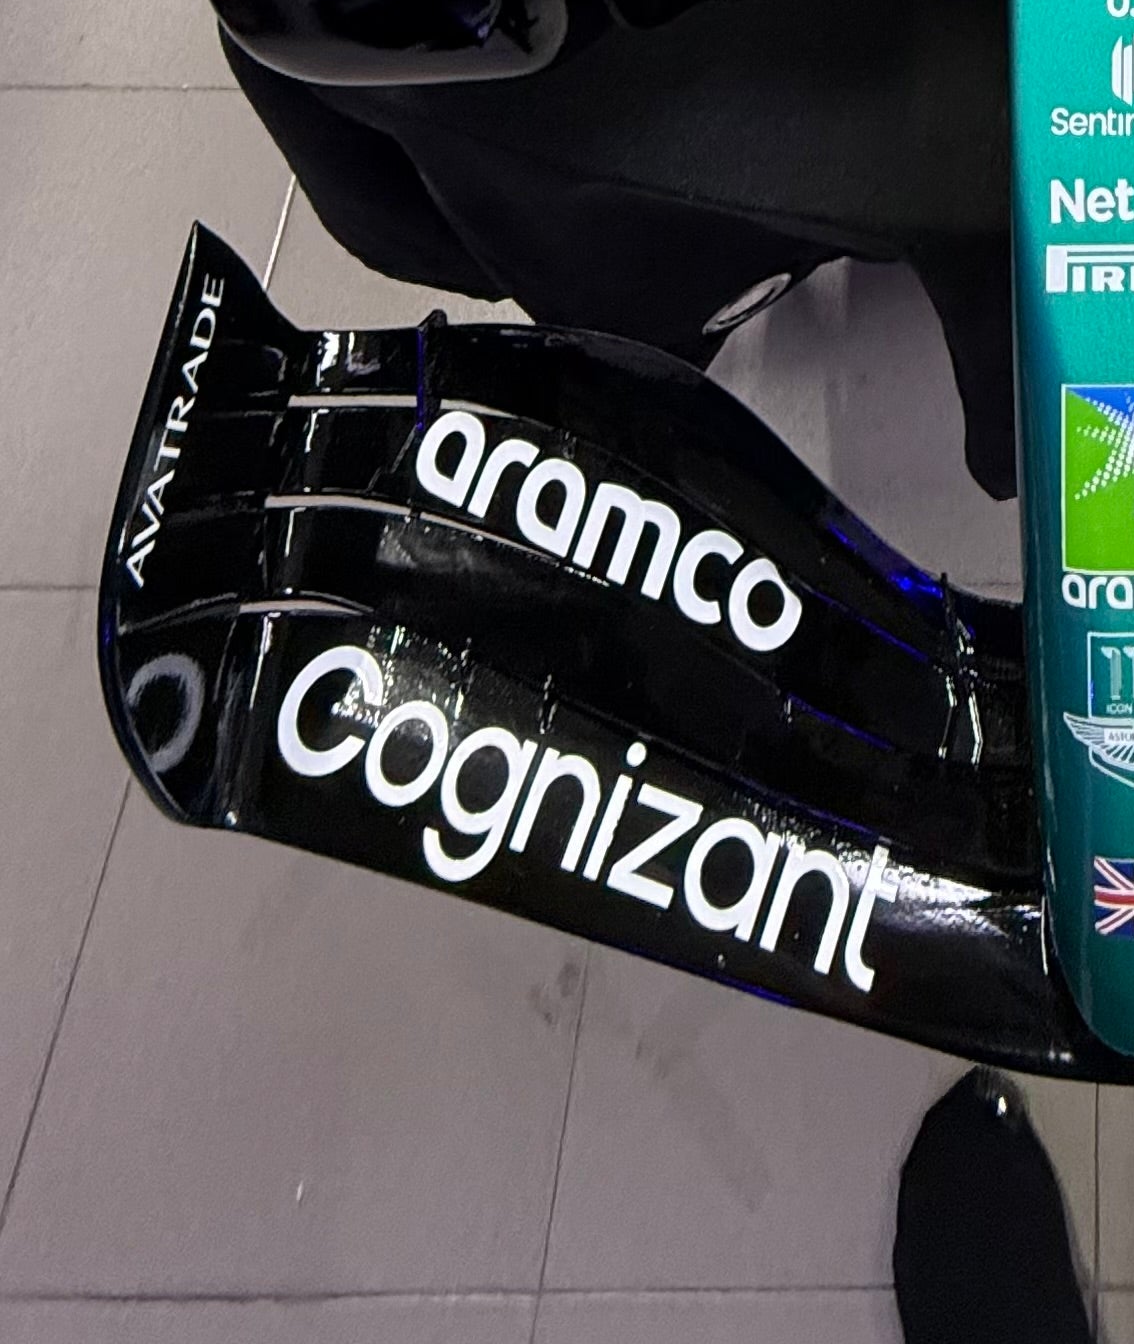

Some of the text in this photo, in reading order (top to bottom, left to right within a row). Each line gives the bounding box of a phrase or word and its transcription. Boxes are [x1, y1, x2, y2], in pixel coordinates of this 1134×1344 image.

[126, 271, 226, 589] AVATRADE
[415, 410, 803, 653] aramco
[276, 644, 899, 993] Cognizant
